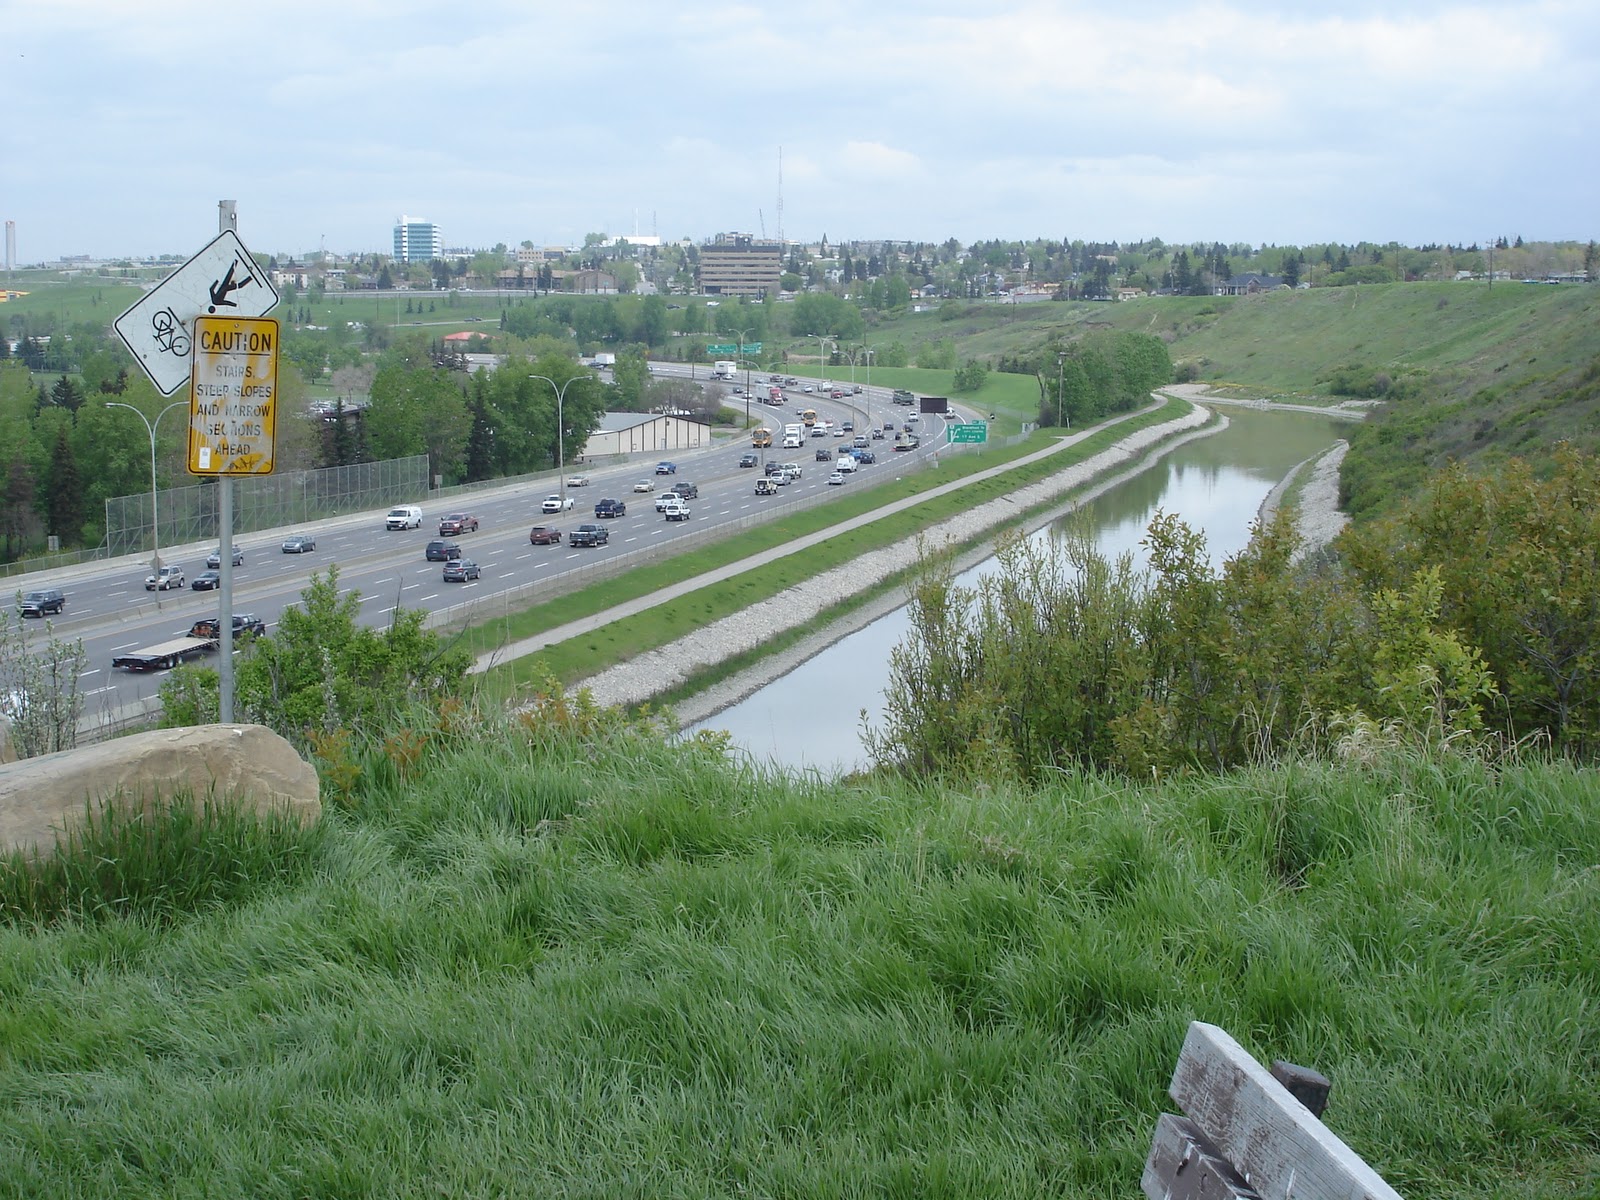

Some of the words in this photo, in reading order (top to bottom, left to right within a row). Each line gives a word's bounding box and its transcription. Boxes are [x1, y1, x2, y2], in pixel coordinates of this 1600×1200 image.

[201, 331, 272, 352] CAUTION
[197, 384, 229, 397] STEEP
[234, 385, 272, 398] SLOPES
[197, 404, 219, 416] AND
[225, 404, 270, 417] NARROW
[215, 444, 250, 455] AHEAD
